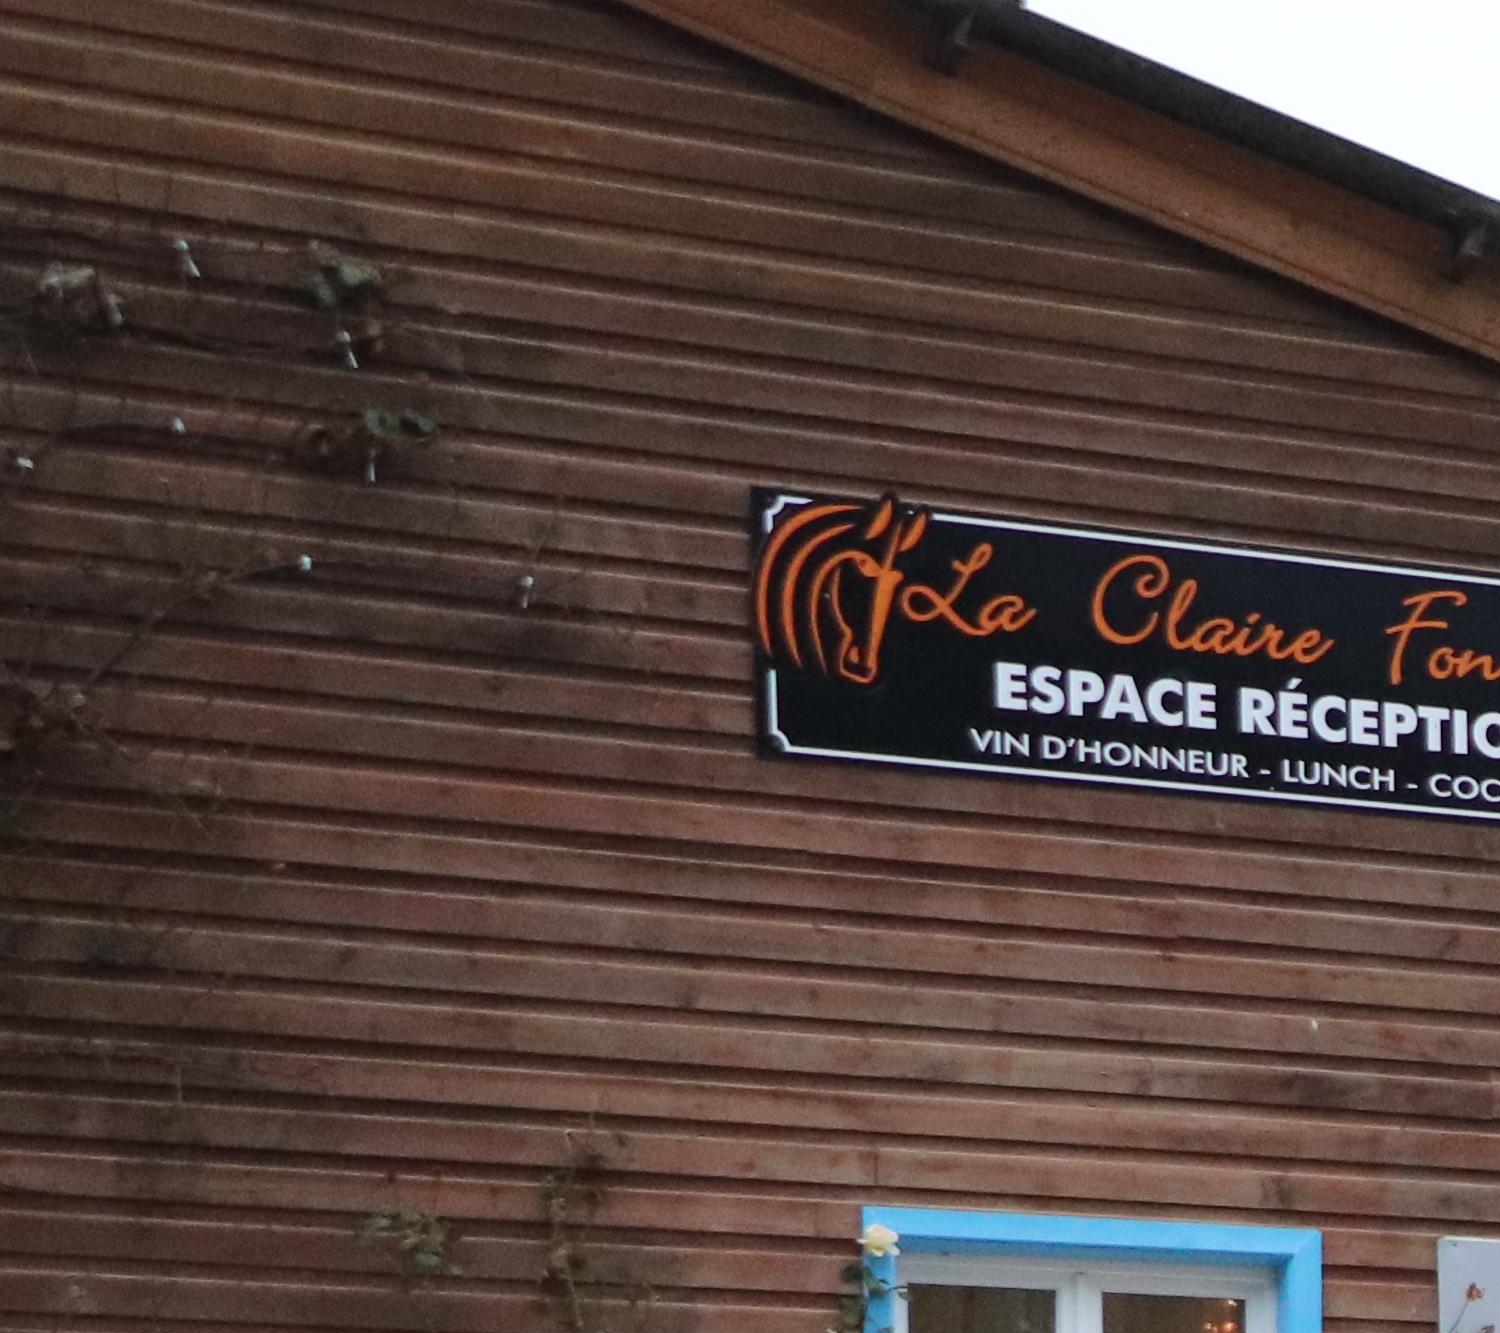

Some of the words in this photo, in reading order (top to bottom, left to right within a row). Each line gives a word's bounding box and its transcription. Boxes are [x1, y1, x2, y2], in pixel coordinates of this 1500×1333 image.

[901, 542, 1037, 636] La
[1093, 554, 1334, 664] Claire
[992, 661, 1217, 729] ESPACE
[970, 727, 1030, 757] VIN
[1041, 734, 1249, 778] D'HONNEUR
[1281, 759, 1396, 792] LUNCH
